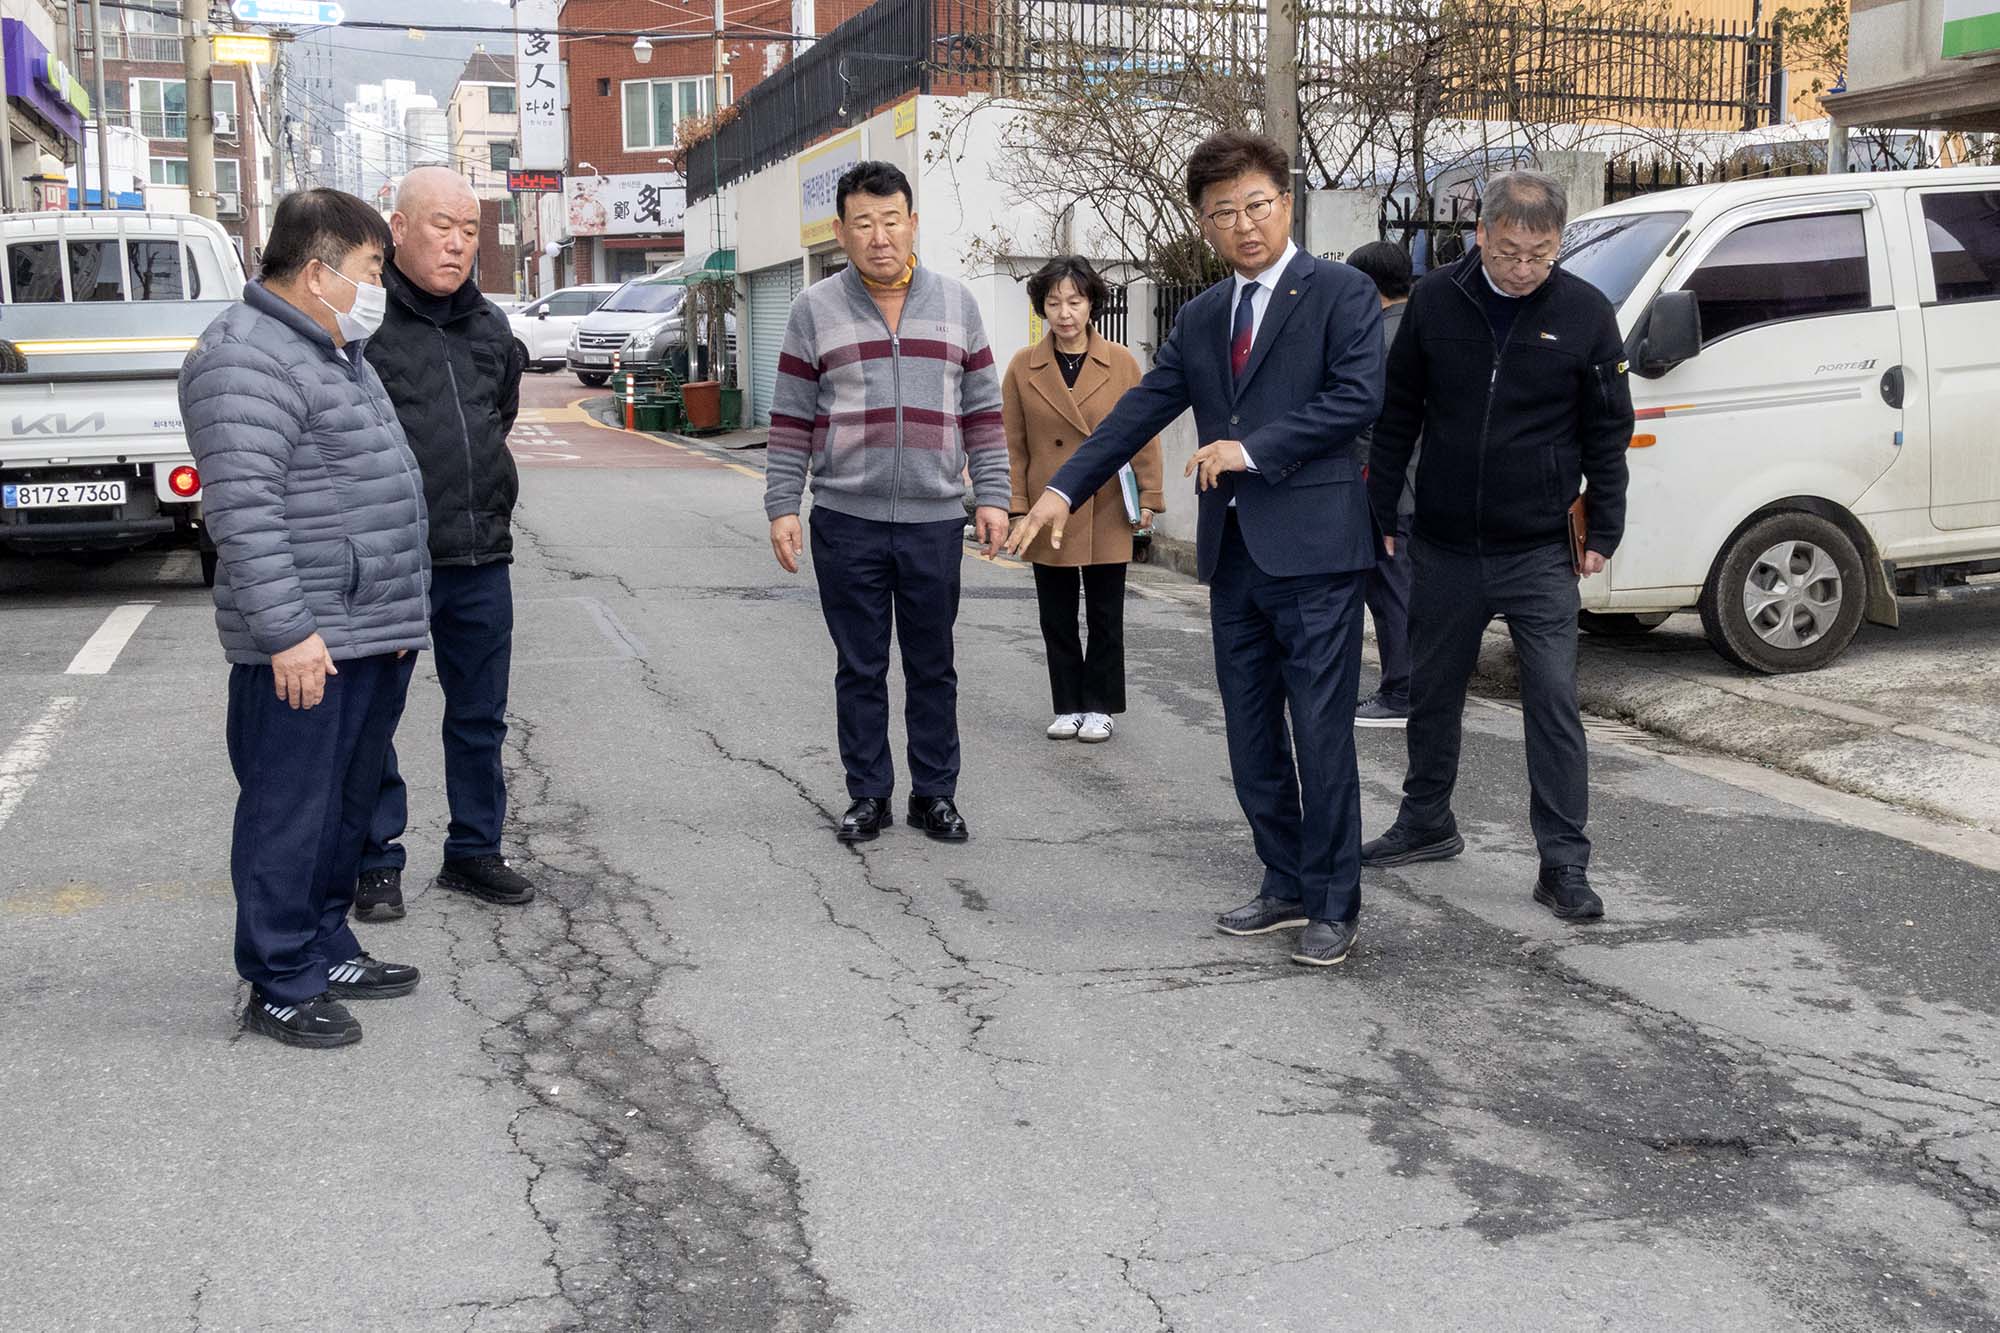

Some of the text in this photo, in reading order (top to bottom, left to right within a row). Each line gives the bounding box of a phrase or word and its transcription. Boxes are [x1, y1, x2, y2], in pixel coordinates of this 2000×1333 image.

[525, 98, 555, 116] 다인
[12, 412, 105, 434] KIA
[19, 483, 121, 505] 817오 7360
